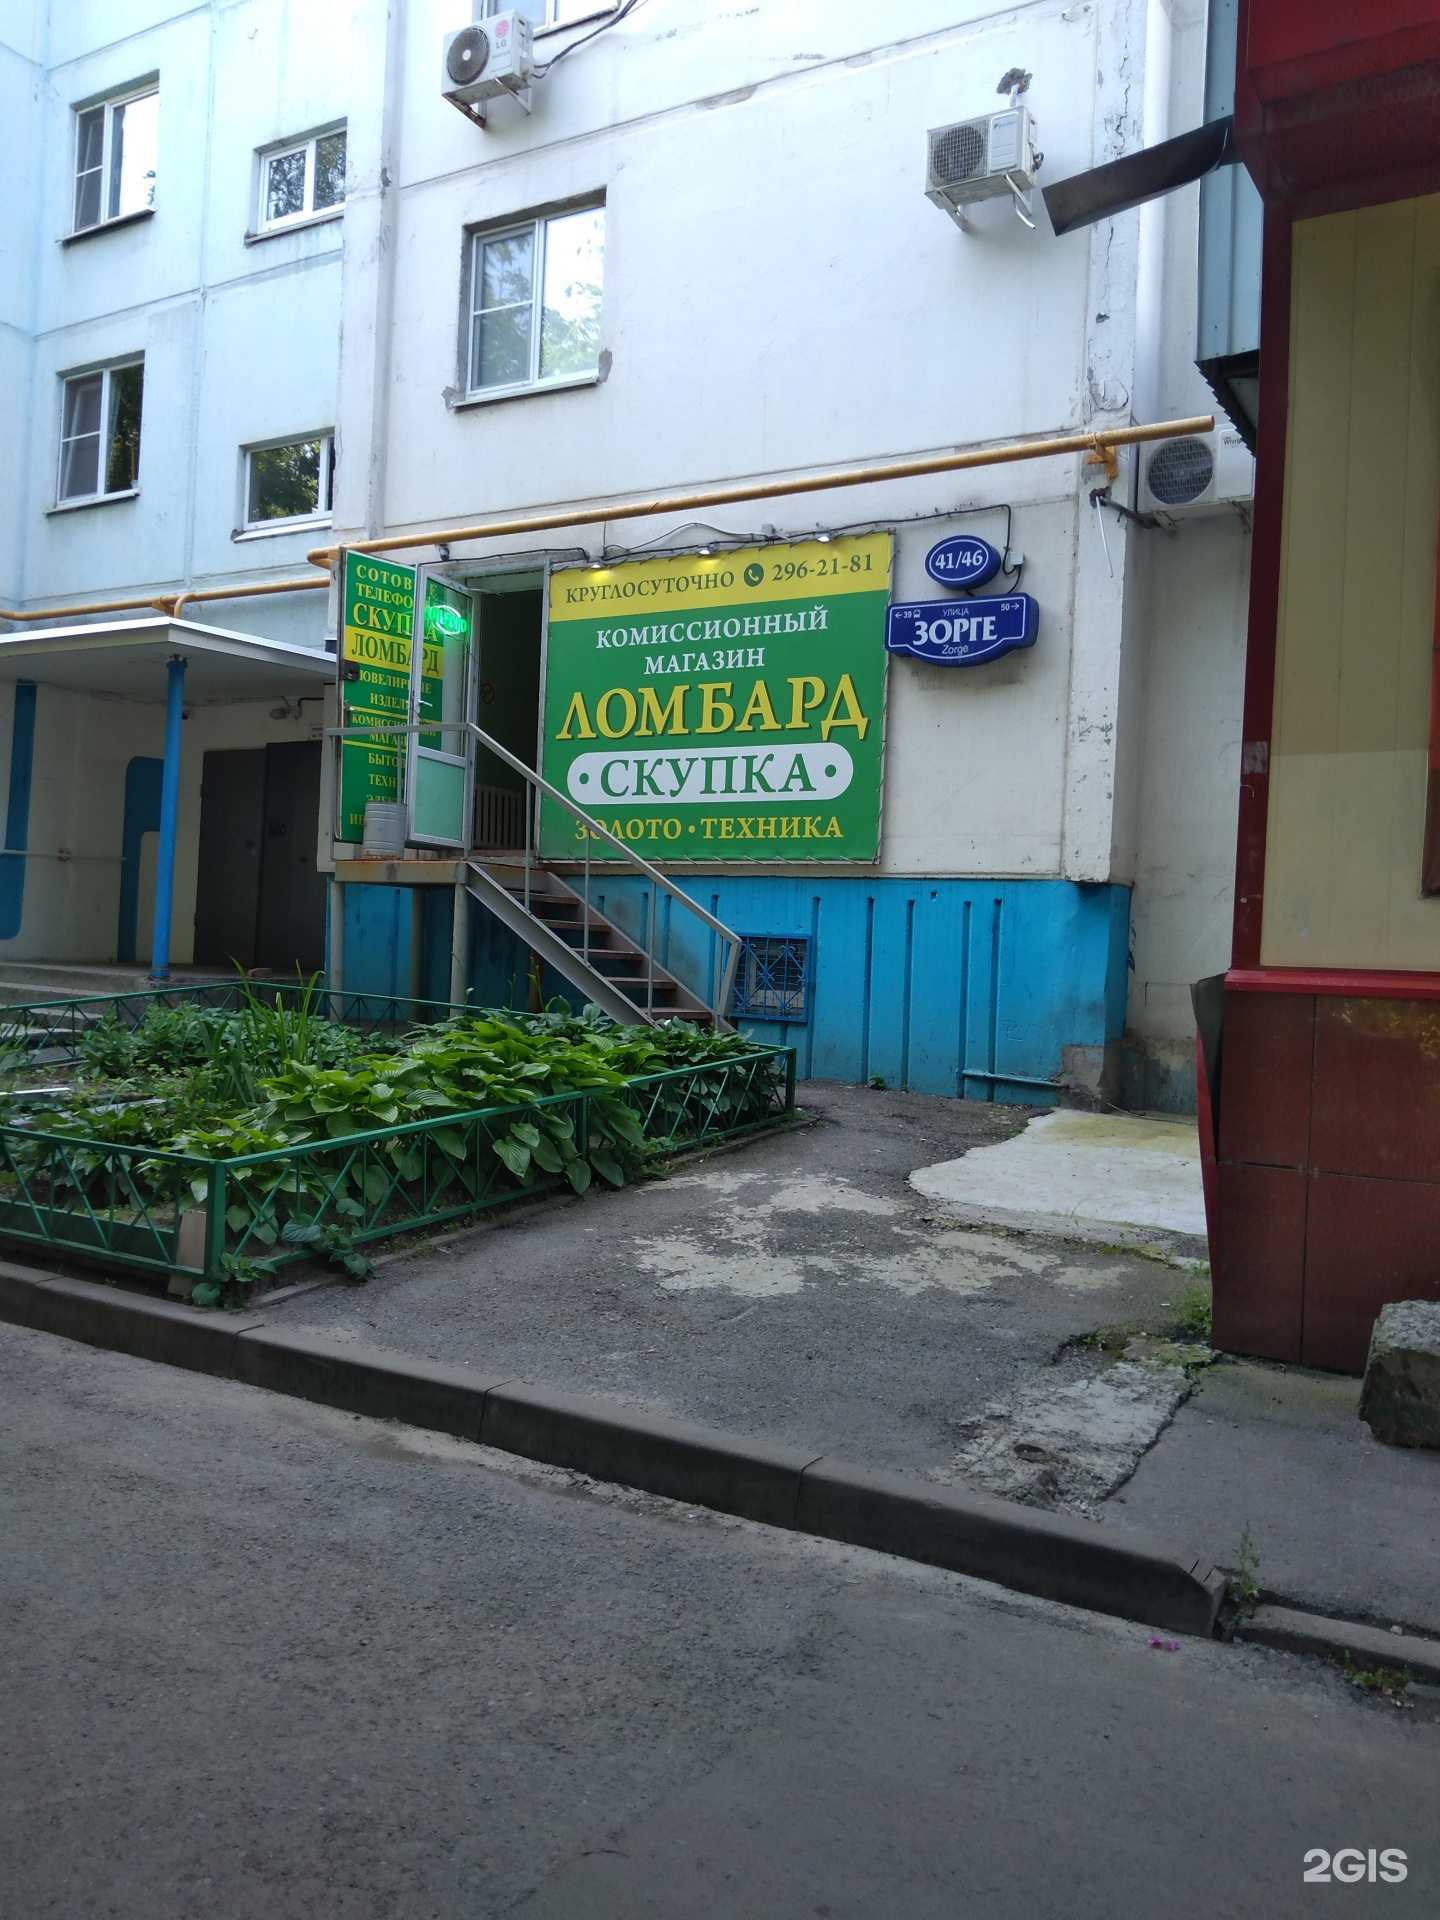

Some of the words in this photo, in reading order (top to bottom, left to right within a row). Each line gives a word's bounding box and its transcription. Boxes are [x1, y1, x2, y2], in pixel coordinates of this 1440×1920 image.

[935, 549, 983, 570] 41/46
[566, 570, 735, 604] КРУГЛОСУТОЧНО
[772, 553, 873, 582] 296-21-81
[595, 604, 829, 650] КОМИССИОННЫЙ
[912, 616, 998, 646] ЗОРГЕ
[643, 647, 766, 675] МАГАЗИН
[941, 644, 969, 657] Zorge
[555, 673, 869, 742] ЛОМБАРД
[600, 753, 817, 797] СКУПКА
[701, 815, 844, 840] ТЕХНИКА
